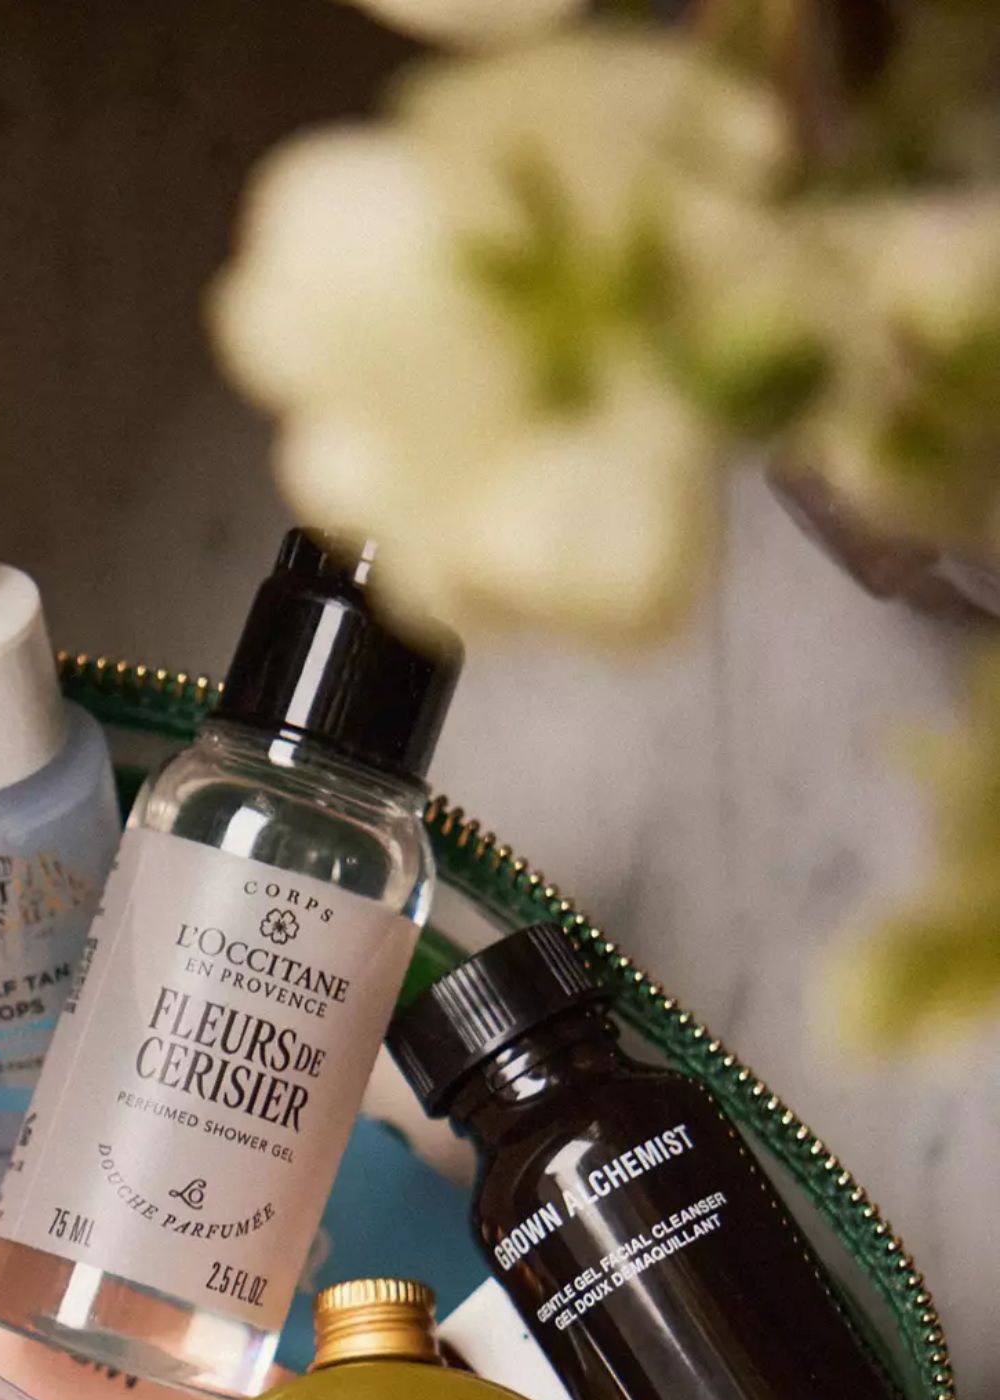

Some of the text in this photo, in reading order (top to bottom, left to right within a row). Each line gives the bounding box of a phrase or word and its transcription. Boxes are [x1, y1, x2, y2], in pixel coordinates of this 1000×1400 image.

[243, 878, 335, 924] CORPS
[24, 962, 73, 991] TAN
[185, 957, 329, 1019] EN PROVENCE
[147, 986, 327, 1079] FLEURS DE
[135, 1036, 310, 1133] CERISIER
[117, 1090, 295, 1164] PERFUMED SHOWER GEL
[98, 1142, 277, 1239] DOUCHE PARFUMÉE
[493, 1124, 697, 1272] GROWN ALCHEMIST
[48, 1207, 94, 1247] 75 ML
[537, 1191, 728, 1323] GENTLE GEL FACIAL CLEANSER
[205, 1261, 234, 1294] 2.5
[554, 1308, 578, 1331] GEL
[576, 1279, 613, 1314] DOUX
